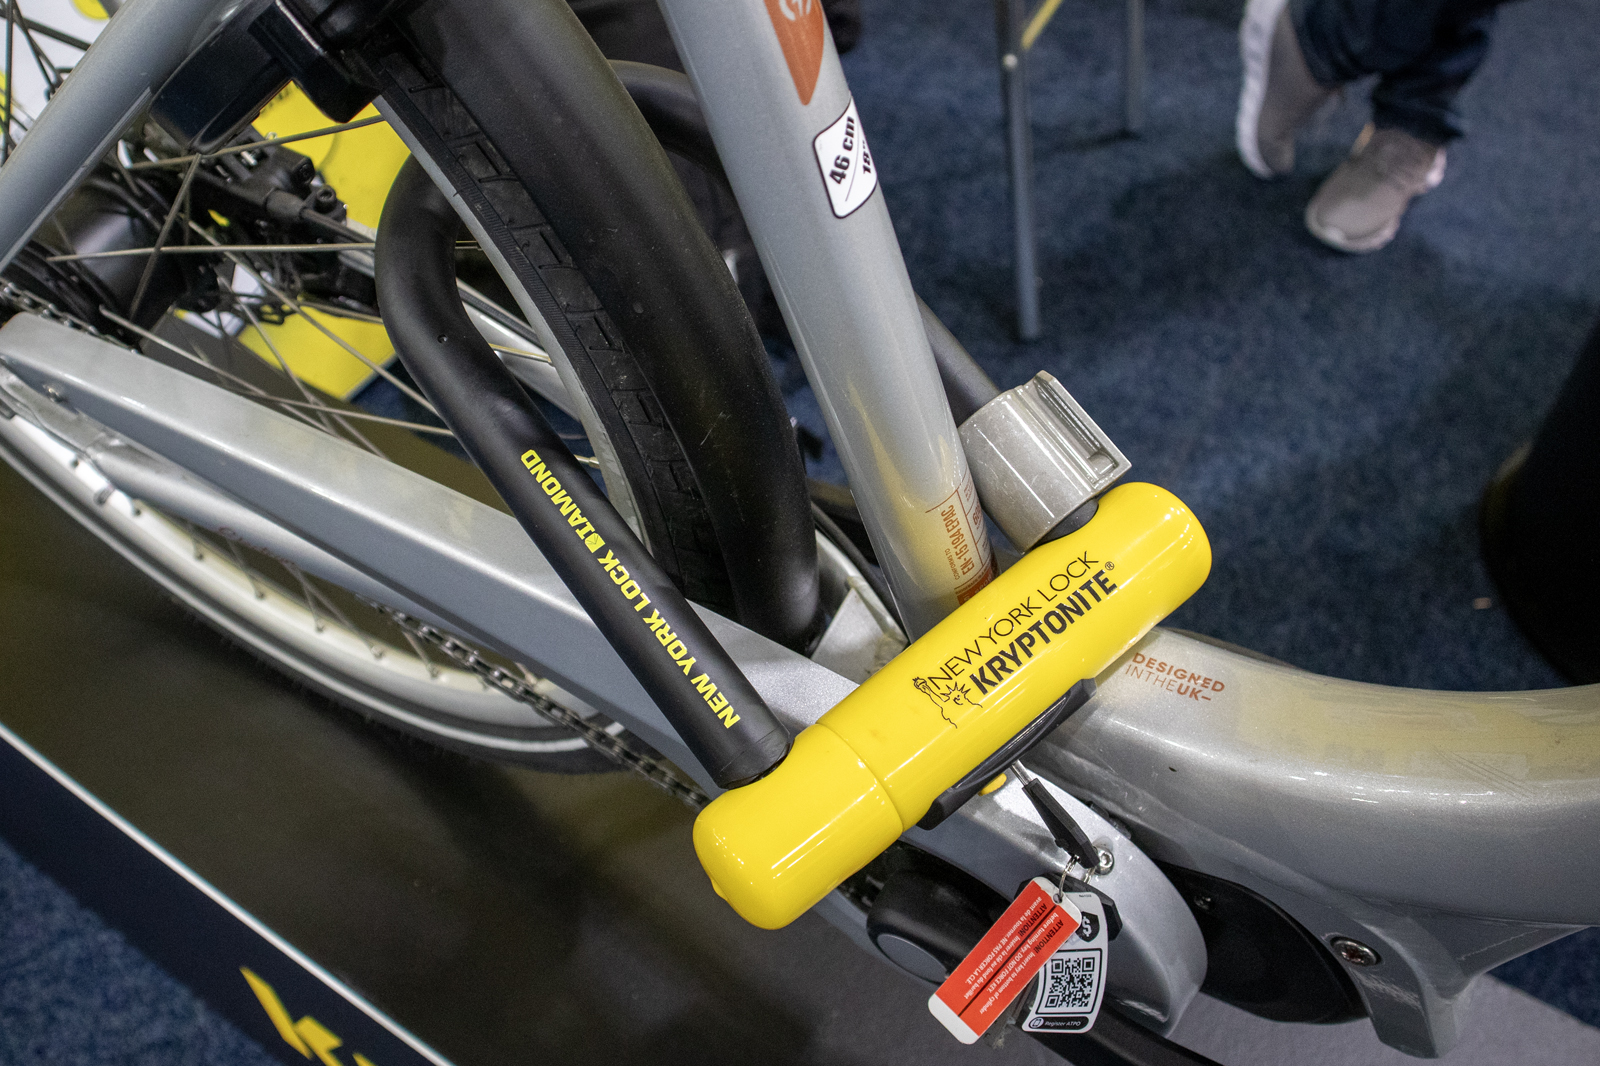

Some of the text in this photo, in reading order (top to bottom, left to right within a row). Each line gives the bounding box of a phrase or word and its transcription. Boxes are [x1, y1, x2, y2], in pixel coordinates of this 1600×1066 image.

[829, 116, 855, 185] 46 cm
[940, 505, 960, 533] EPAC
[949, 528, 975, 575] EN-15194
[520, 449, 741, 729] NEW YORK LOCK DIAMOND
[928, 639, 982, 690] NEW
[979, 596, 1042, 645] YORK
[1037, 551, 1099, 602] LOCK
[1132, 653, 1225, 692] DESIGNED
[1029, 896, 1042, 911] avant
[1018, 903, 1047, 936] ATTENTION!
[1024, 909, 1031, 917] de
[1042, 912, 1059, 929] before
[1034, 919, 1063, 953] ATTENTION!
[992, 943, 1002, 954] PAS
[1014, 952, 1023, 961] DO
[978, 951, 995, 970] FORCER
[1006, 959, 1017, 971] NOT
[1021, 951, 1035, 966] Insert
[972, 967, 981, 976] LA
[994, 968, 1009, 984] FORCE
[1014, 963, 1024, 973] key
